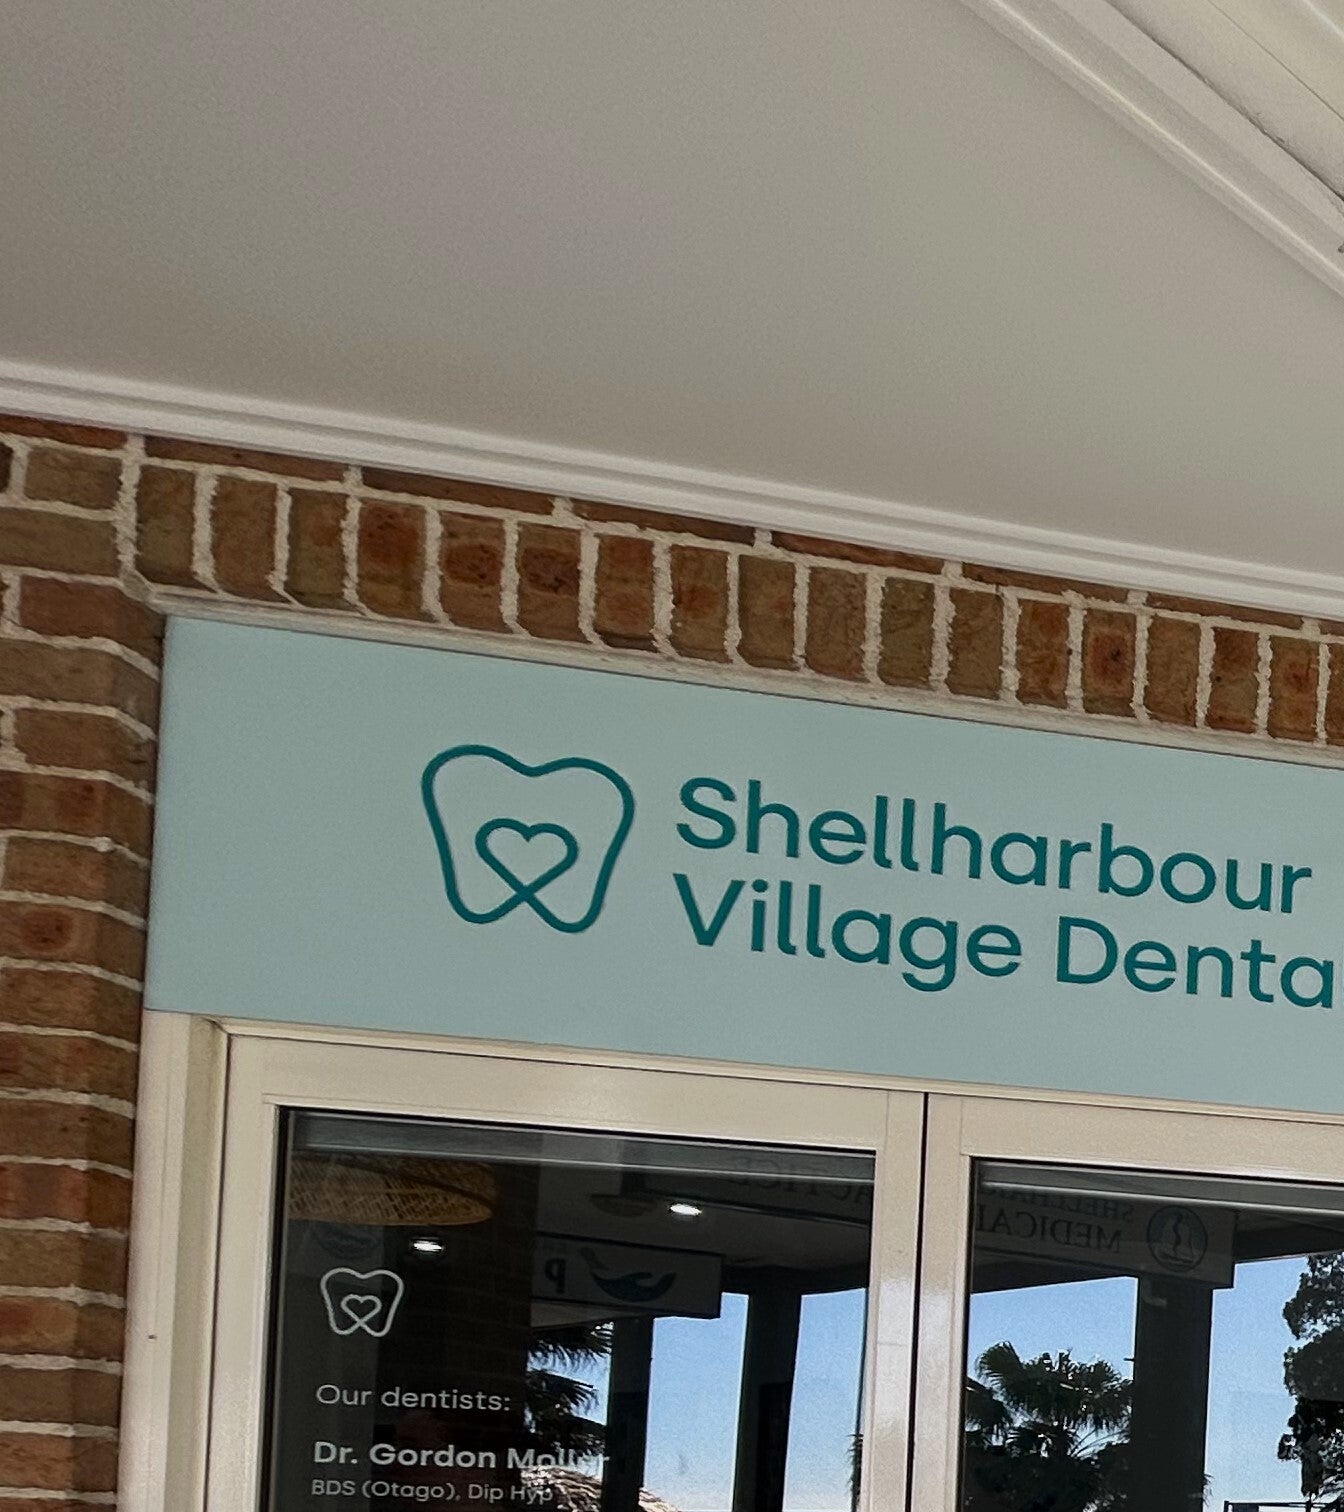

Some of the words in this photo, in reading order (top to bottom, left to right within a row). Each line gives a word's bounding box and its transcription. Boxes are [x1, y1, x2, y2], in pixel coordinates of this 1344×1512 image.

[675, 778, 1313, 916] Shellharbour
[674, 873, 1023, 992] Village
[316, 1384, 372, 1406] Our
[381, 1386, 511, 1411] dentists:
[313, 1441, 358, 1465] Dr.
[369, 1443, 496, 1469] Gordon
[311, 1479, 355, 1496] BDS
[361, 1479, 460, 1501] (Otago),
[468, 1482, 505, 1506] Dip
[510, 1484, 553, 1506] Hyp
